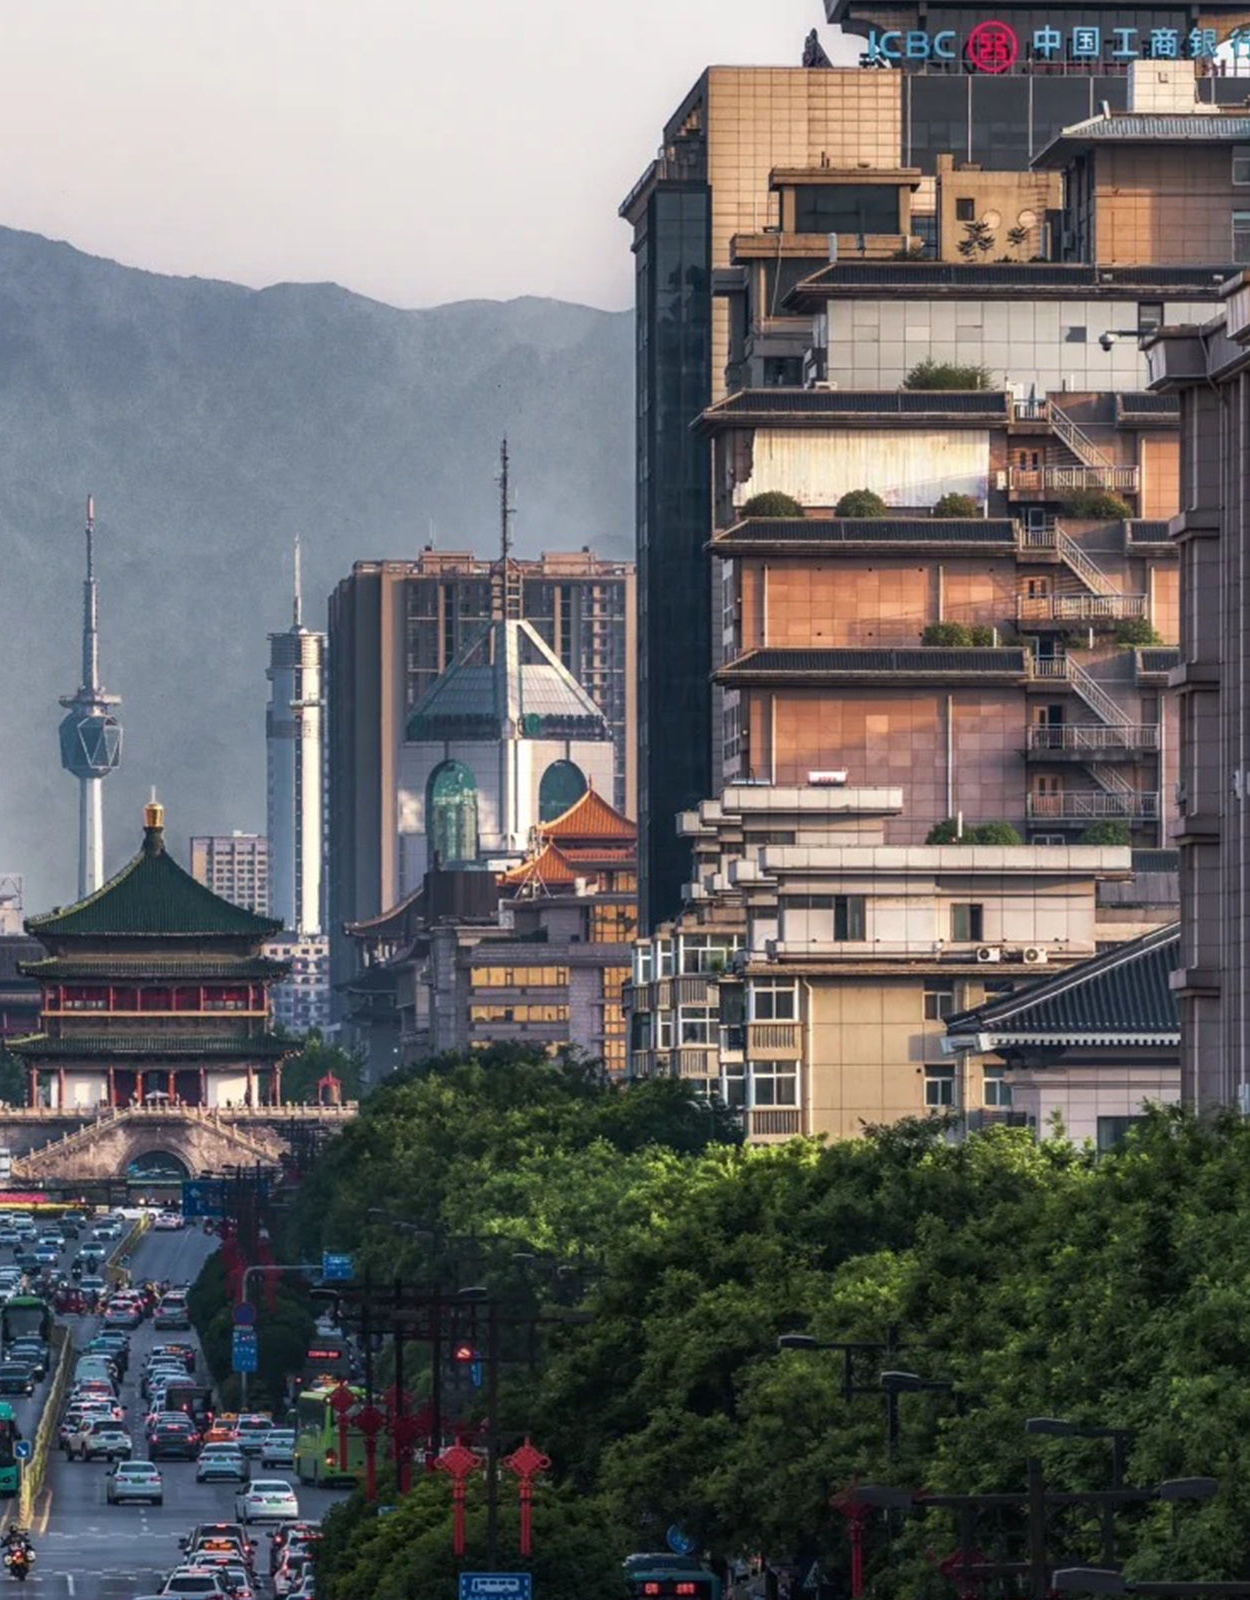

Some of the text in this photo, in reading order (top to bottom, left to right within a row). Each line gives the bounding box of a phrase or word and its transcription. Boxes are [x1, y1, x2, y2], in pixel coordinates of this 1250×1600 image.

[868, 30, 956, 59] ICBC
[1033, 24, 1250, 59] 中国工商银行
